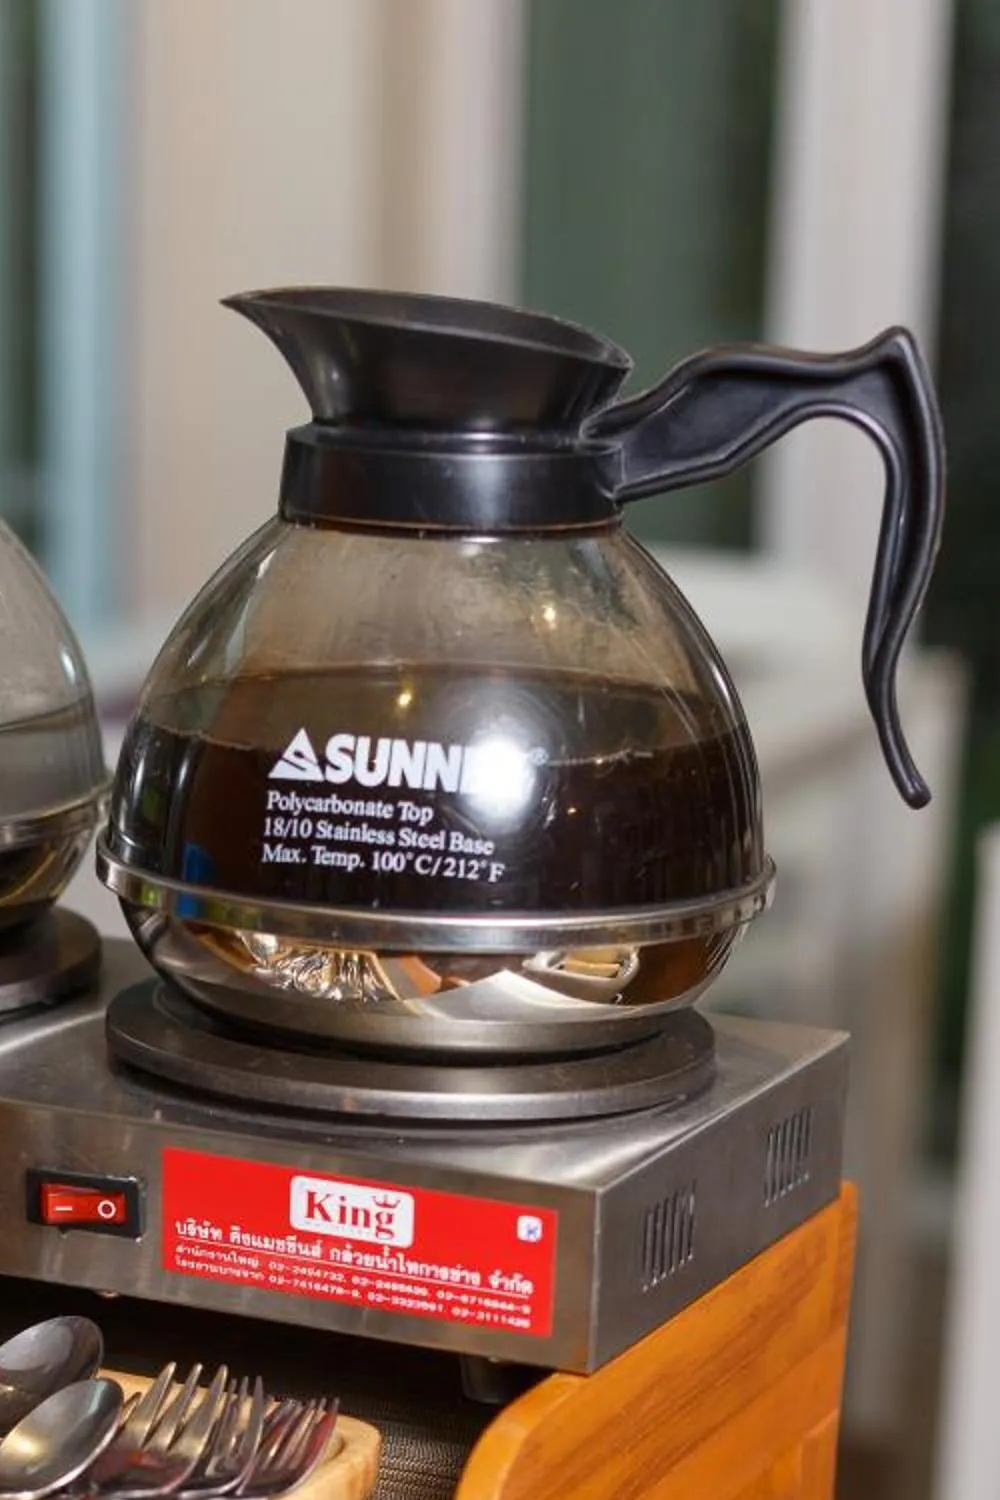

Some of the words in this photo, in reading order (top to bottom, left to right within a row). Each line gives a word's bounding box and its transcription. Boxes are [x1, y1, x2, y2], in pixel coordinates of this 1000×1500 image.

[325, 733, 535, 797] SUNN
[266, 790, 395, 819] Polycarbonate
[397, 801, 434, 826] Top
[261, 843, 307, 863] Max.
[311, 845, 365, 872] Temp.
[264, 816, 312, 838] 18/10
[316, 819, 396, 845] Stainless
[398, 827, 446, 850] Steel
[449, 831, 495, 855] Base
[306, 1190, 394, 1240] King
[176, 1217, 222, 1240] บริษัท
[488, 1269, 533, 1294] จำกัด
